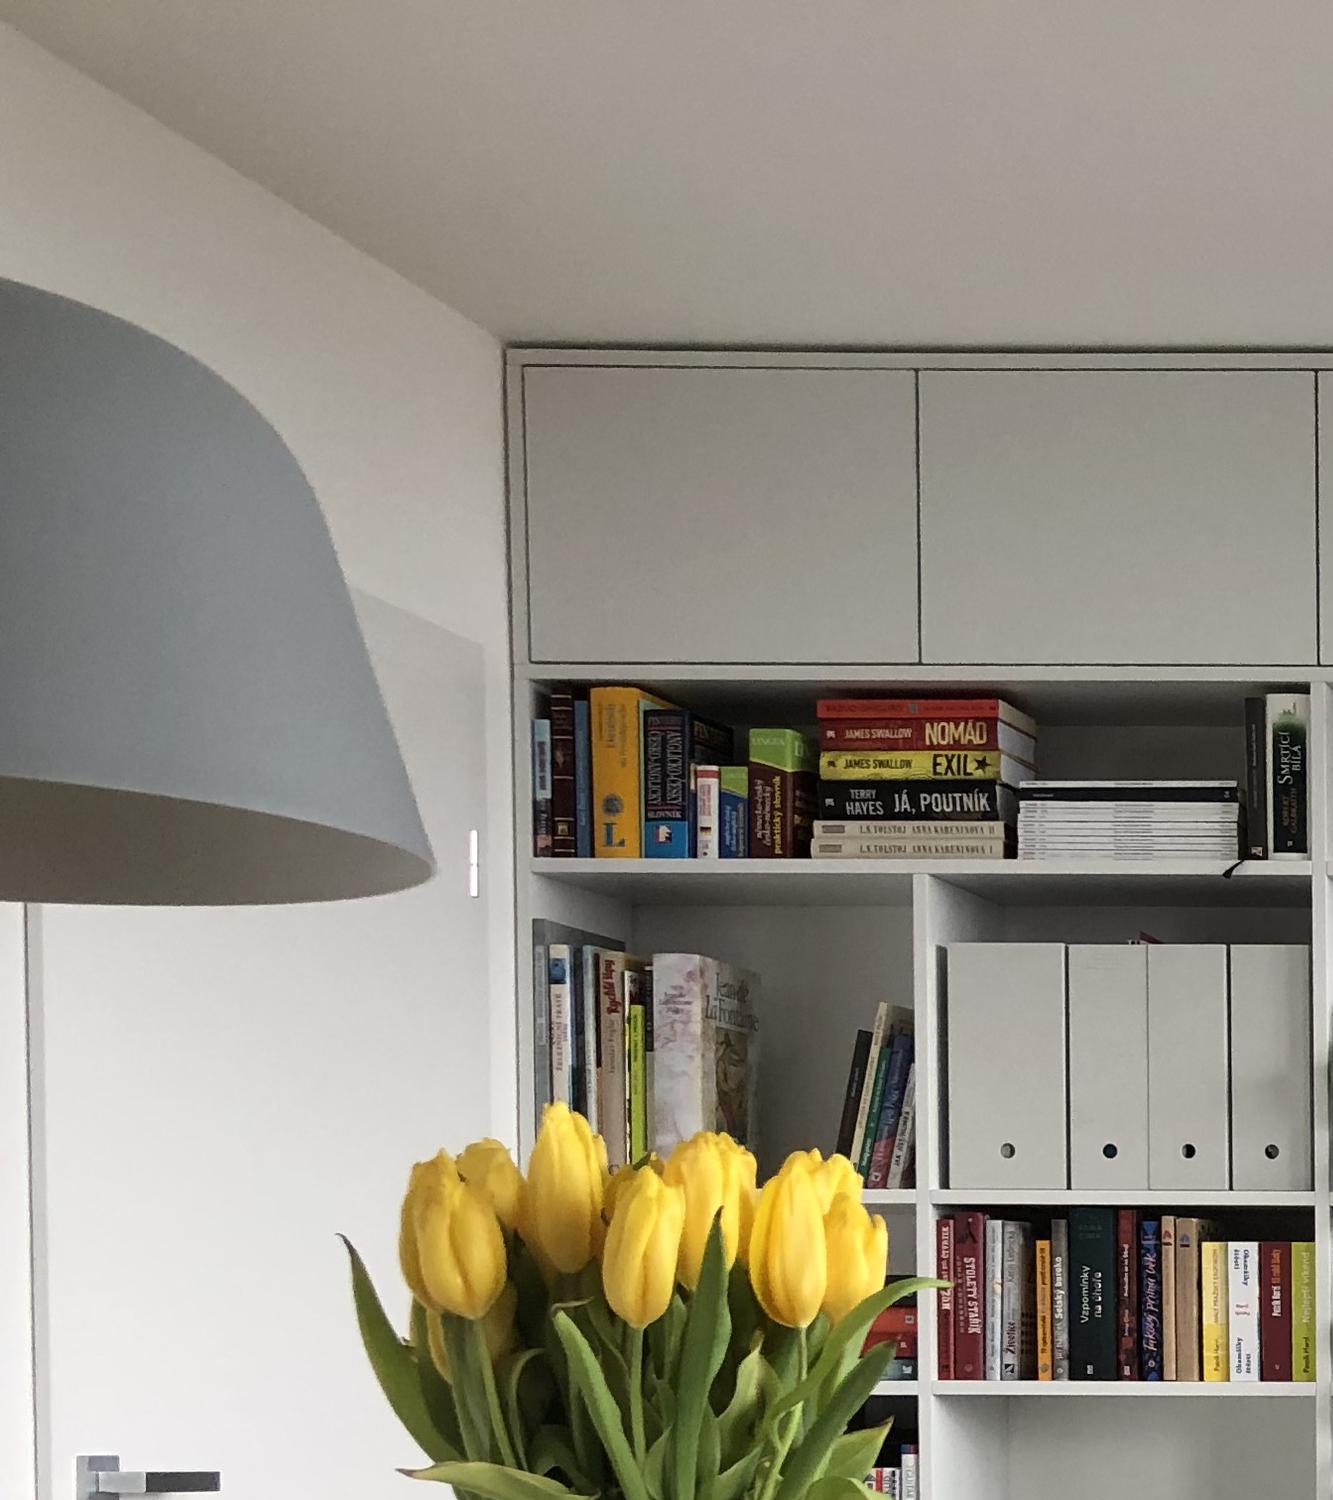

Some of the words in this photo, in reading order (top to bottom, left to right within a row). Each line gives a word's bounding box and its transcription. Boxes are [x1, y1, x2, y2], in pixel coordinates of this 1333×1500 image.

[844, 728, 871, 739] JAMES
[871, 727, 912, 739] SWALLOW
[925, 720, 987, 745] NOMÁD
[667, 731, 687, 806] ANGLICKO-ČESKÝ
[843, 759, 871, 769] JAMES
[873, 759, 912, 769] SWALLOW
[932, 753, 974, 776] EXIL
[1277, 731, 1293, 784] SMRTÍCÍ
[1290, 745, 1302, 771] BÍLÁ
[773, 775, 782, 809] slovník
[850, 789, 876, 799] TERRY
[894, 788, 916, 814] JÁ,
[920, 788, 990, 812] POUTNÍK
[846, 801, 884, 815] HAYES
[773, 810, 783, 855] praktický
[874, 825, 906, 834] TOLSTOJ
[912, 825, 932, 834] ANNA
[874, 845, 906, 854] TOLSTOJ
[912, 845, 932, 854] ANNA
[603, 981, 621, 1014] Rychlé
[1144, 1252, 1158, 1274] věk
[1302, 1252, 1310, 1283] víkend
[1080, 1266, 1090, 1323] Vzpomínky
[1093, 1272, 1102, 1302] úhoře
[1144, 1278, 1158, 1312] prima
[967, 1301, 982, 1334] STAŘÍK
[1054, 1290, 1065, 1319] Selský
[1095, 1305, 1102, 1318] na
[1003, 1322, 1015, 1354] Životice
[1144, 1314, 1159, 1351] Takový
[1235, 1337, 1243, 1374] Okamžiky
